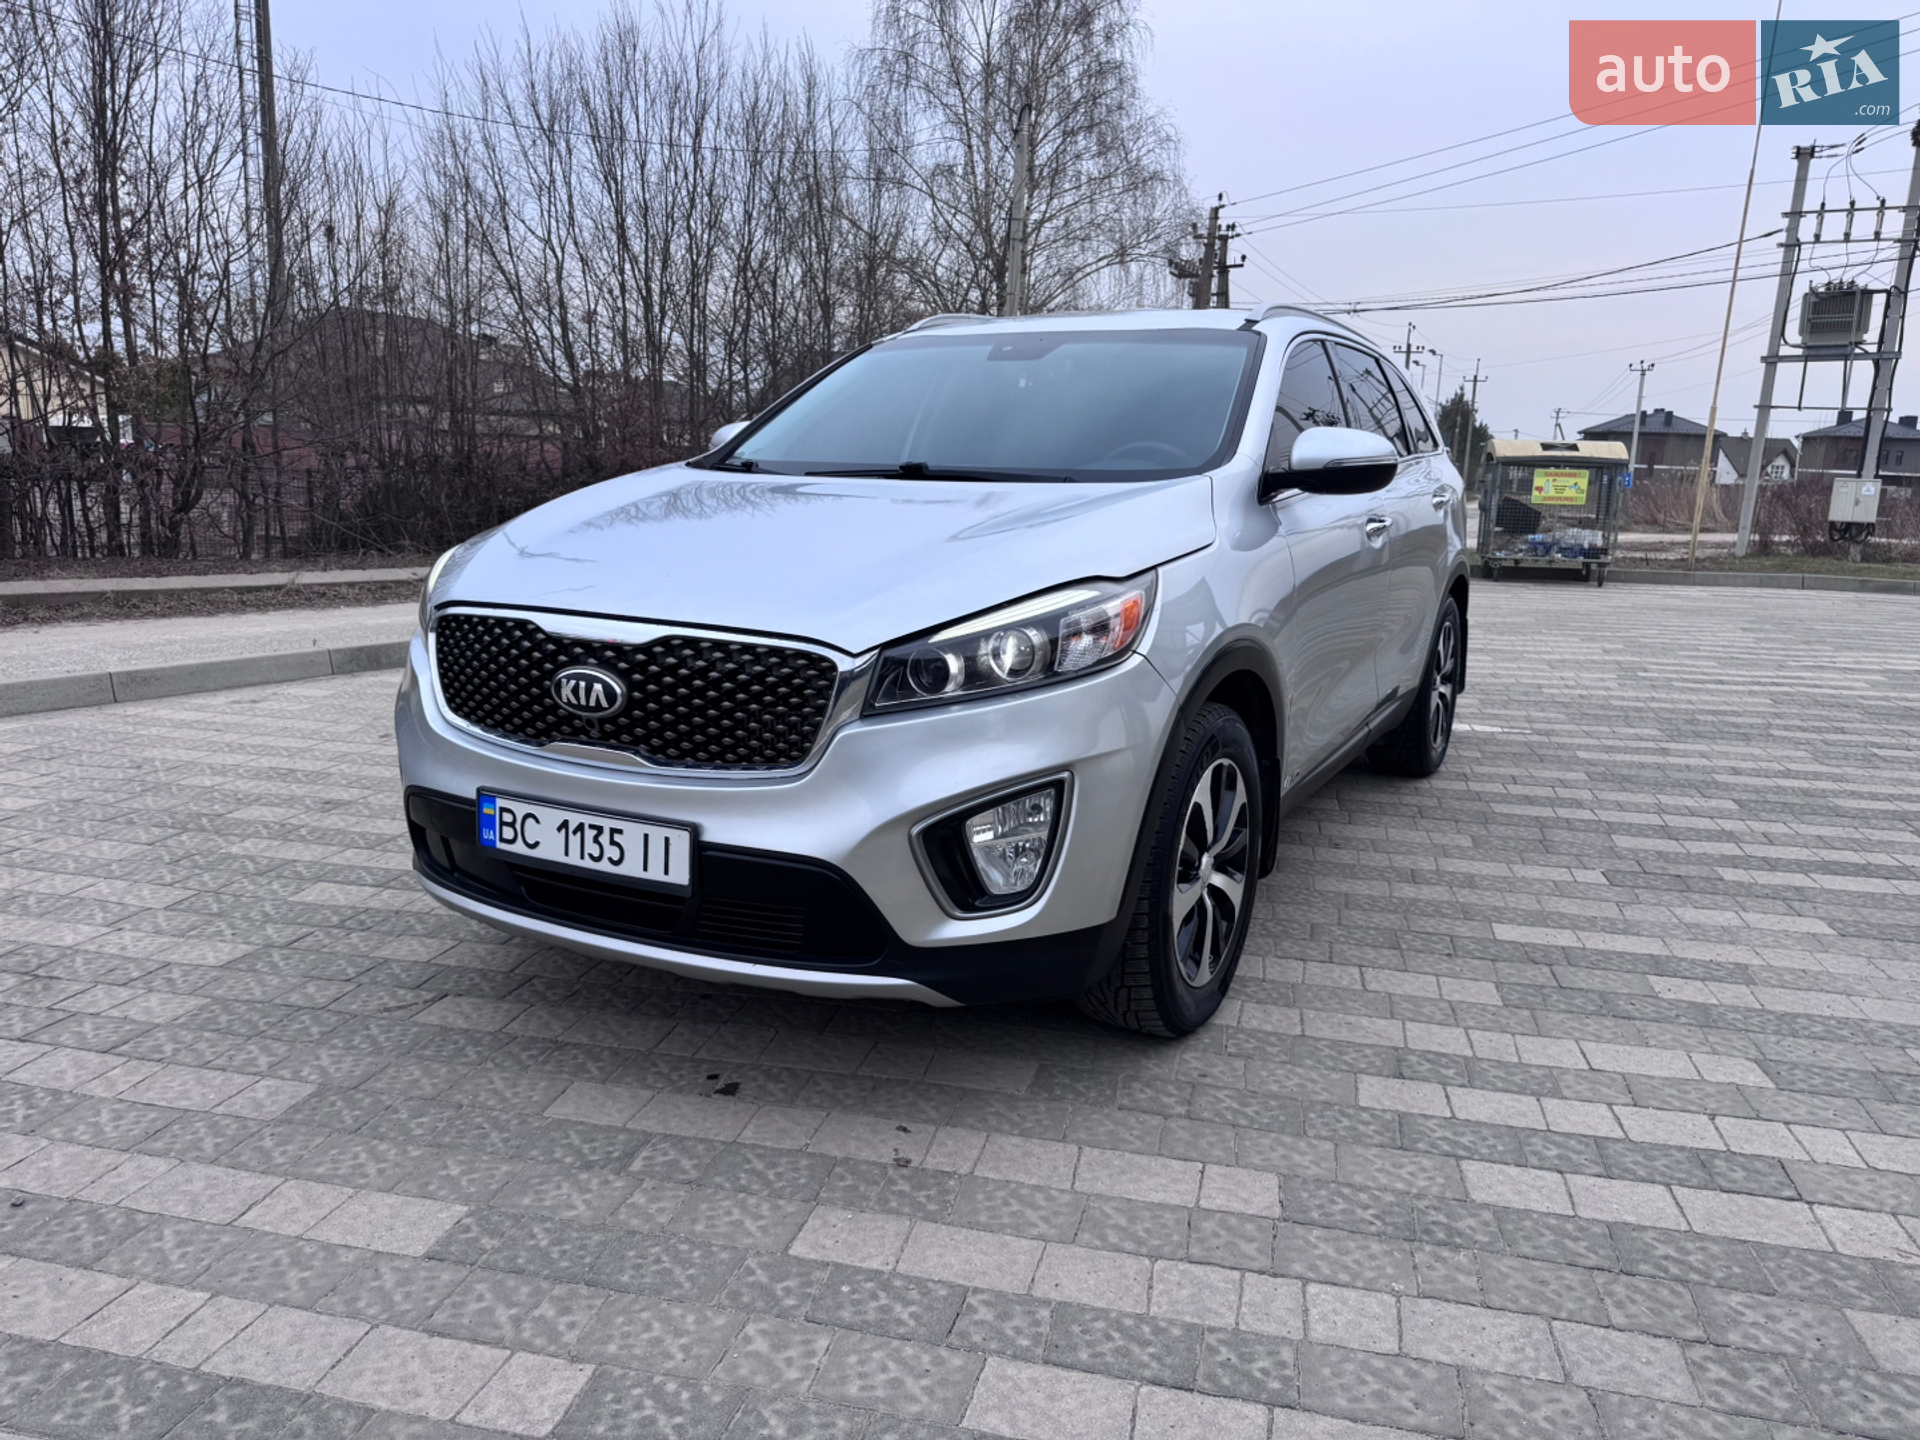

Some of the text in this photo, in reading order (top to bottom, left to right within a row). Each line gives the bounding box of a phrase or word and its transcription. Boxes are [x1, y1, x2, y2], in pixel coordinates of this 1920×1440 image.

[561, 678, 609, 708] KIA
[482, 828, 495, 841] UA
[499, 806, 541, 850] BC
[556, 818, 625, 867] 1135
